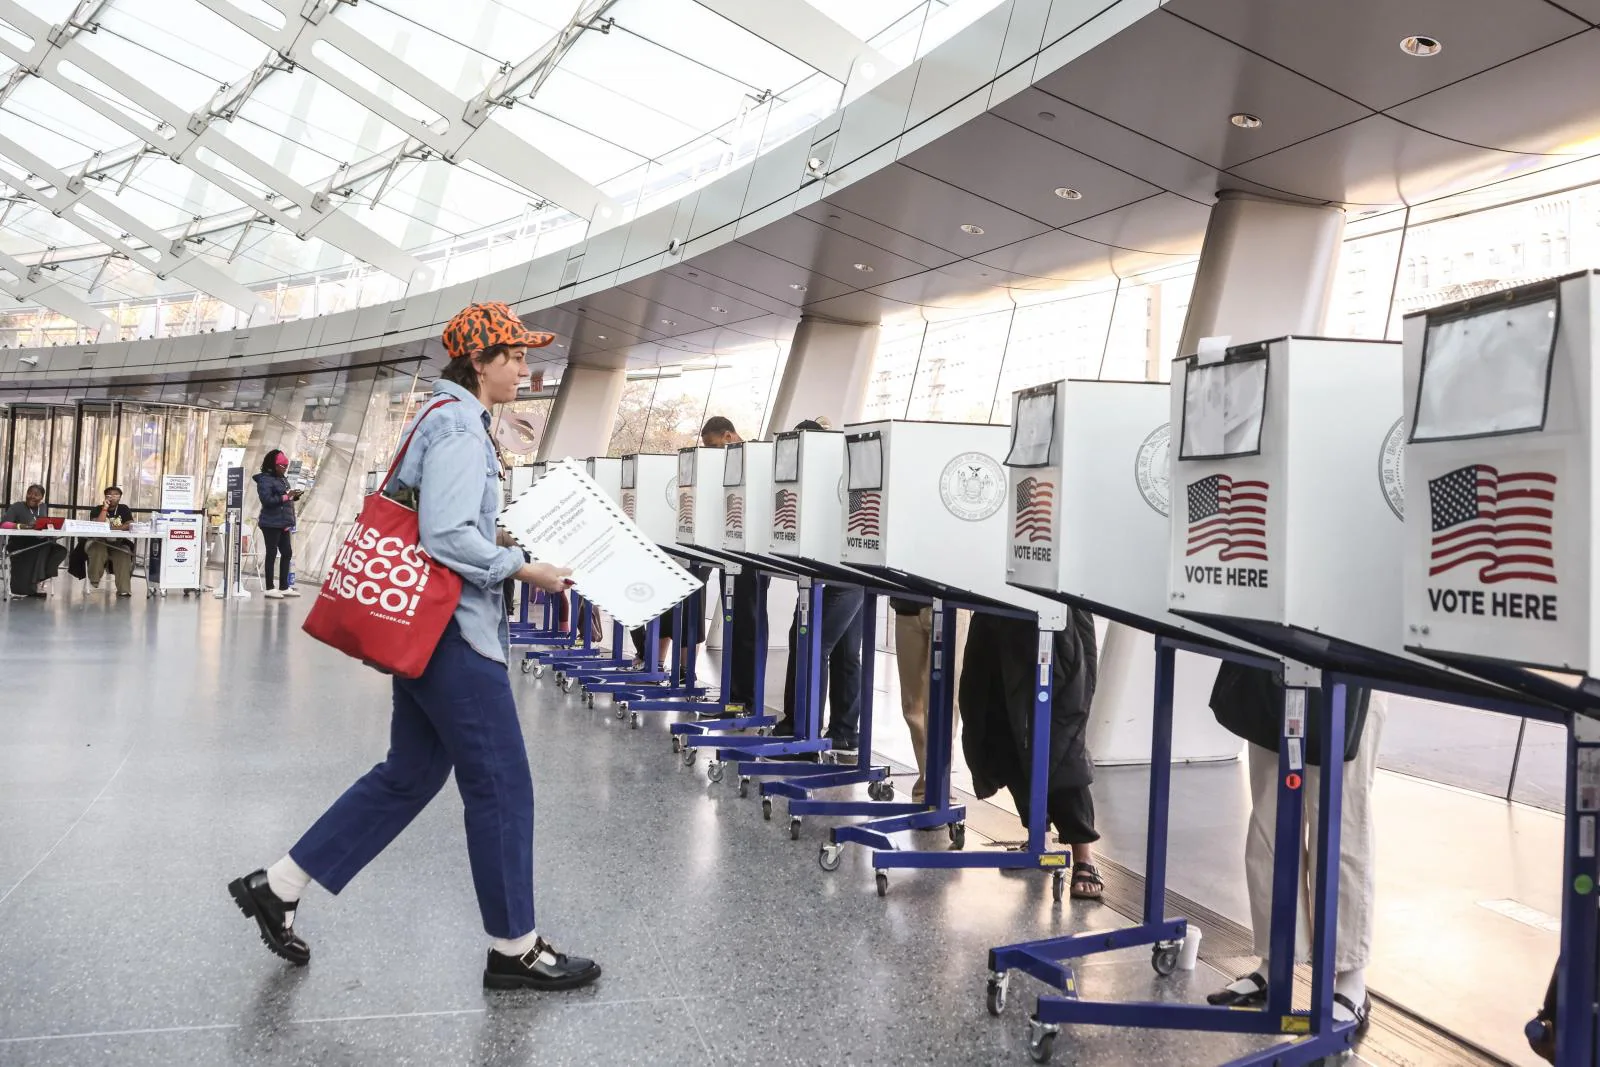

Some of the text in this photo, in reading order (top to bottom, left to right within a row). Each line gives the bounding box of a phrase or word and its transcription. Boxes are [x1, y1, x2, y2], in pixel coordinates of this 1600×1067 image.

[726, 530, 734, 538] VOTE
[774, 532, 796, 541] VOTE HERE
[847, 537, 879, 550] VOTE HERE
[1014, 545, 1051, 562] VOTE HERE
[335, 544, 429, 592] IASCO!
[1185, 565, 1268, 588] VOTE HERE
[1428, 588, 1557, 621] VOTE HERE
